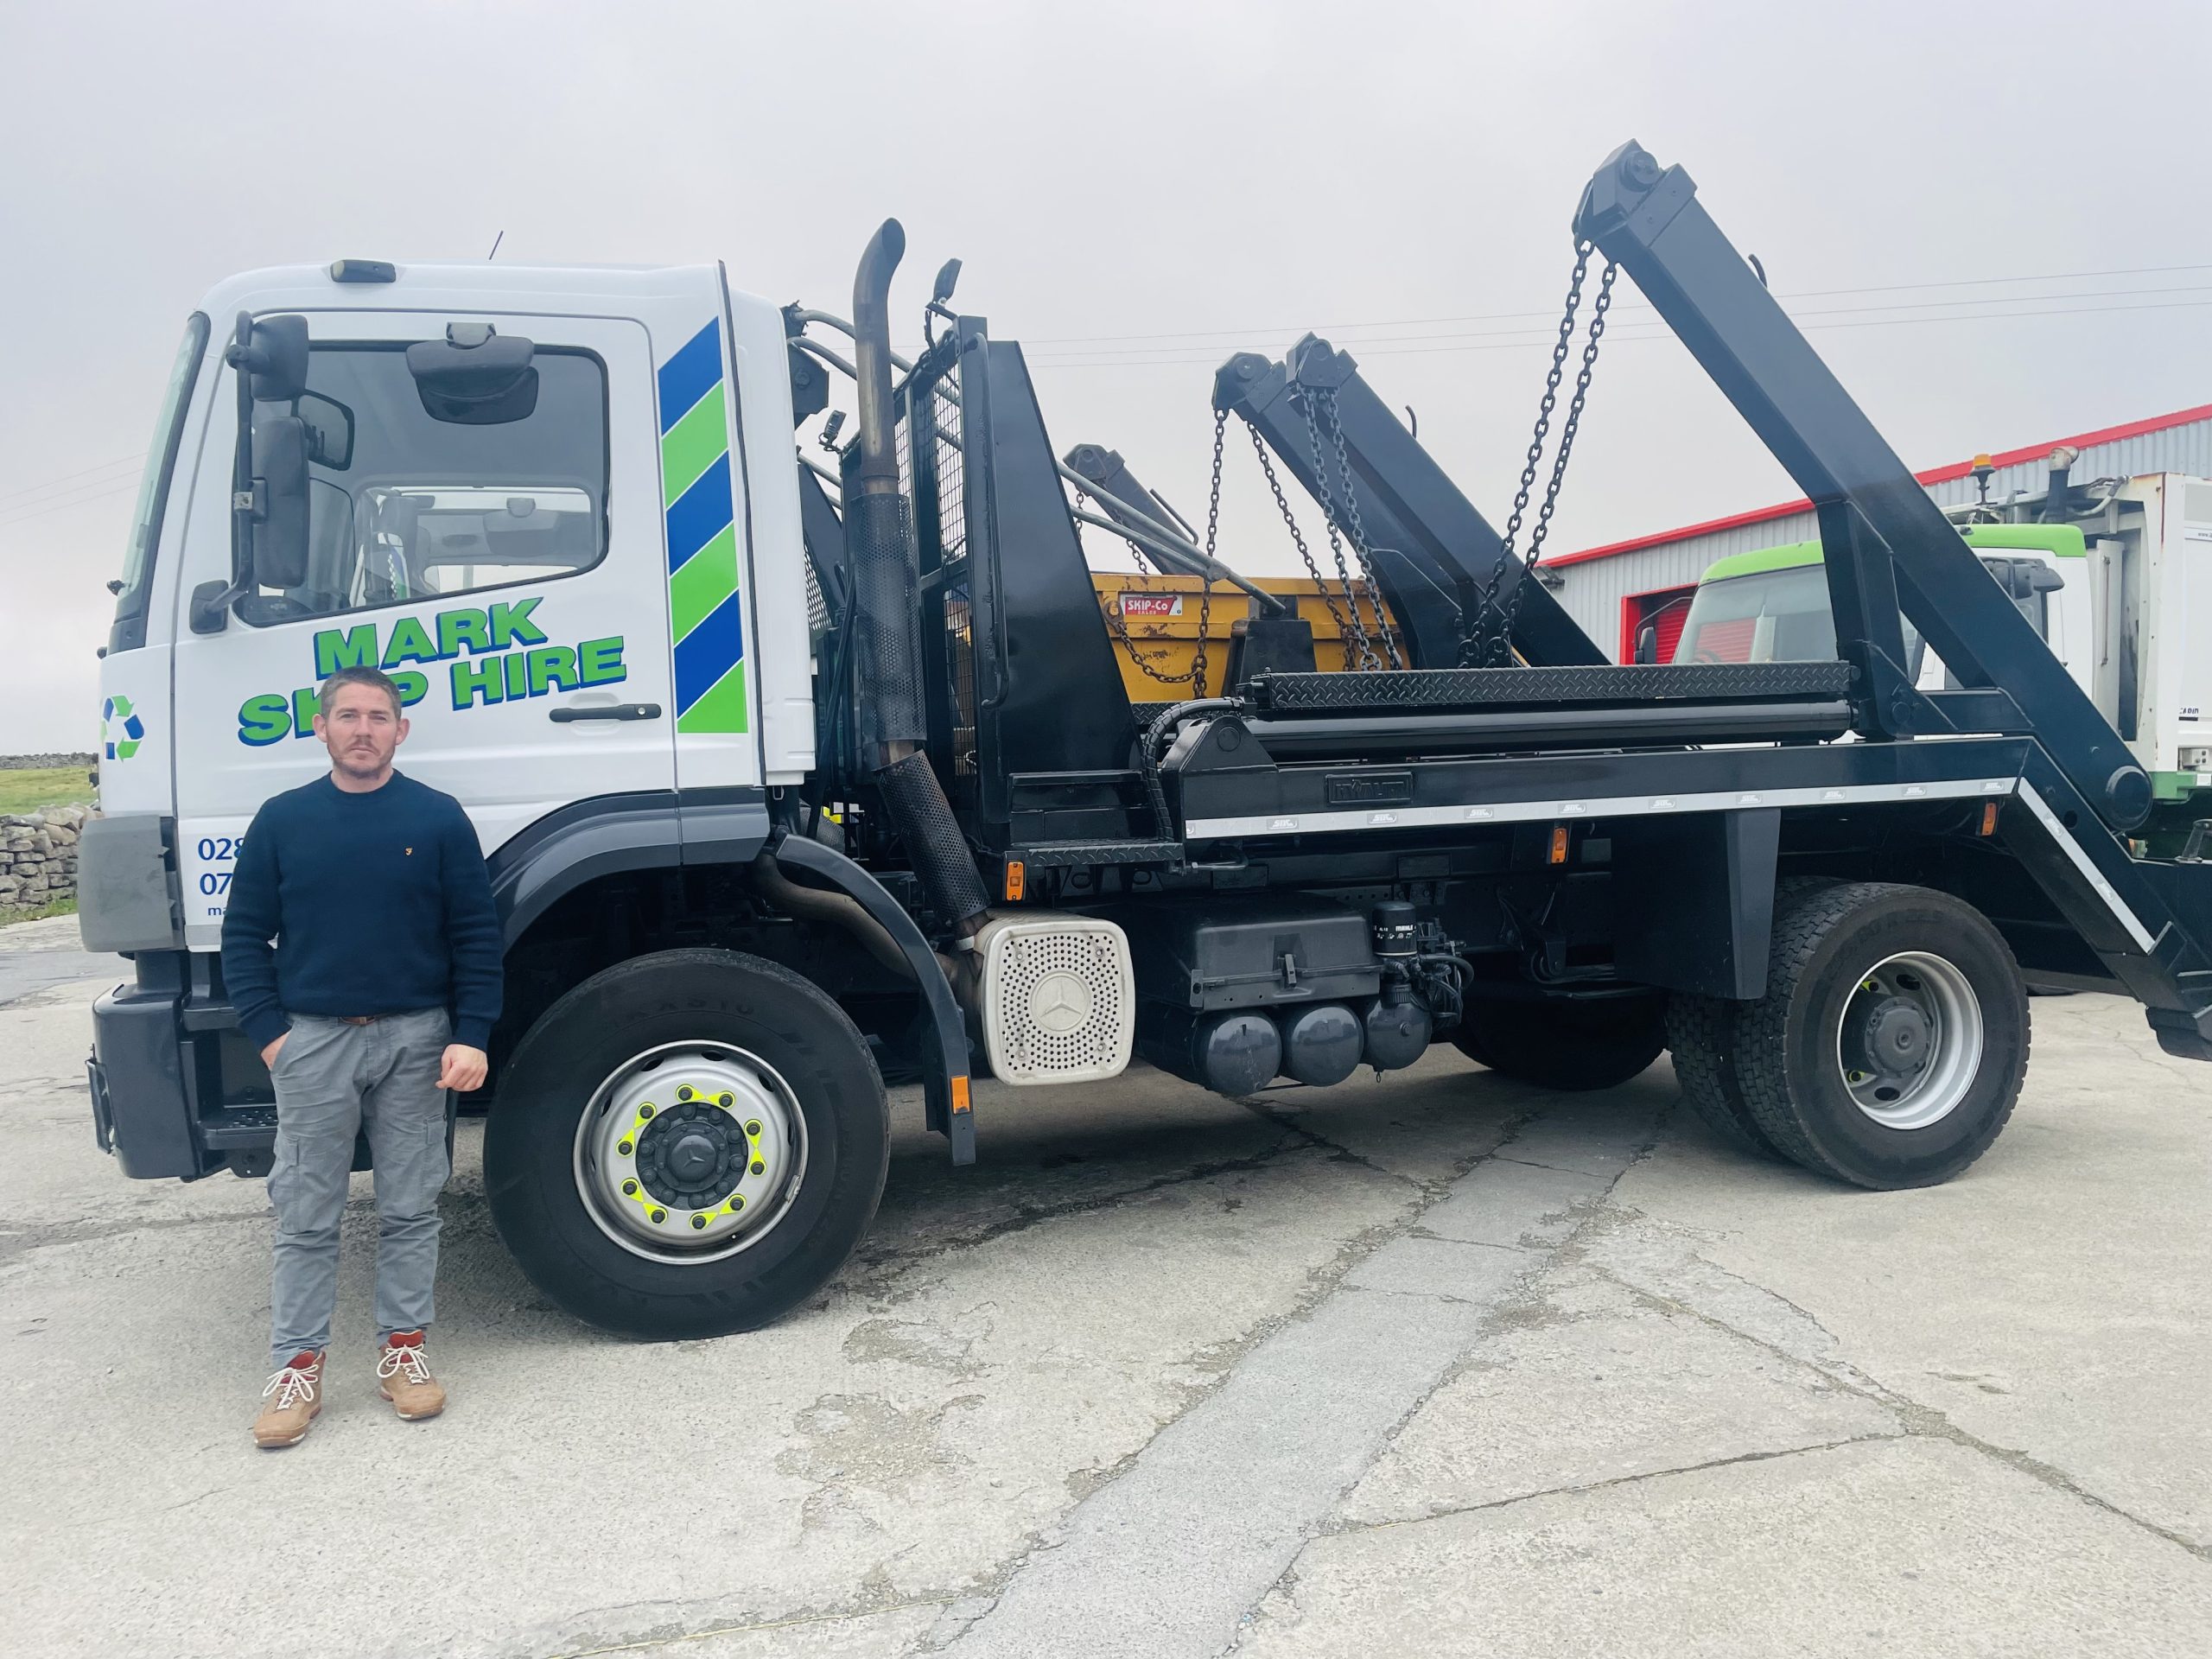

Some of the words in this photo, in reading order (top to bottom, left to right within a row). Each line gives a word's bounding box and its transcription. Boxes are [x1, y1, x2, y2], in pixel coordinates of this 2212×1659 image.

[314, 596, 549, 681] MARK
[1128, 600, 1168, 610] SKIP-Co
[238, 671, 429, 747] SKP
[449, 635, 627, 711] HIRE
